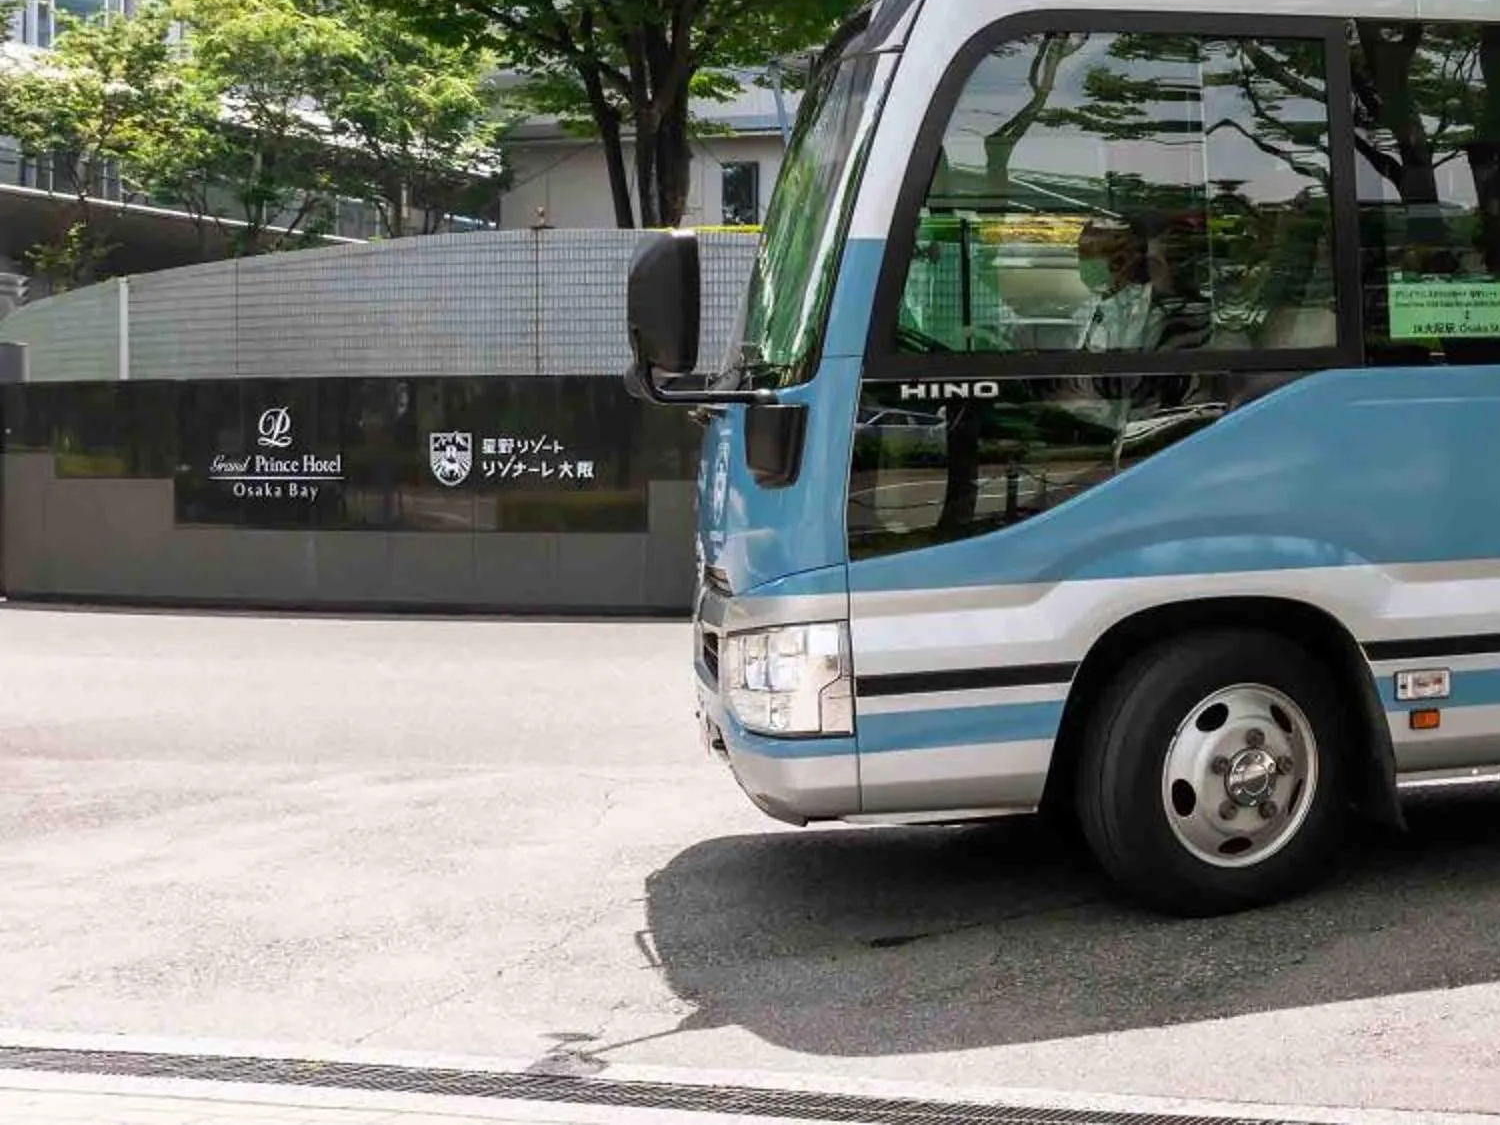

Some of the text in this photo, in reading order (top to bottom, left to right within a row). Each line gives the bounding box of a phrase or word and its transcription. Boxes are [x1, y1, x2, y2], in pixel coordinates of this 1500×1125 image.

[901, 381, 999, 399] HINO
[482, 435, 565, 454] 星野リゾート
[209, 454, 341, 473] Grand Prince Hotel
[233, 482, 319, 502] Osaka Bay
